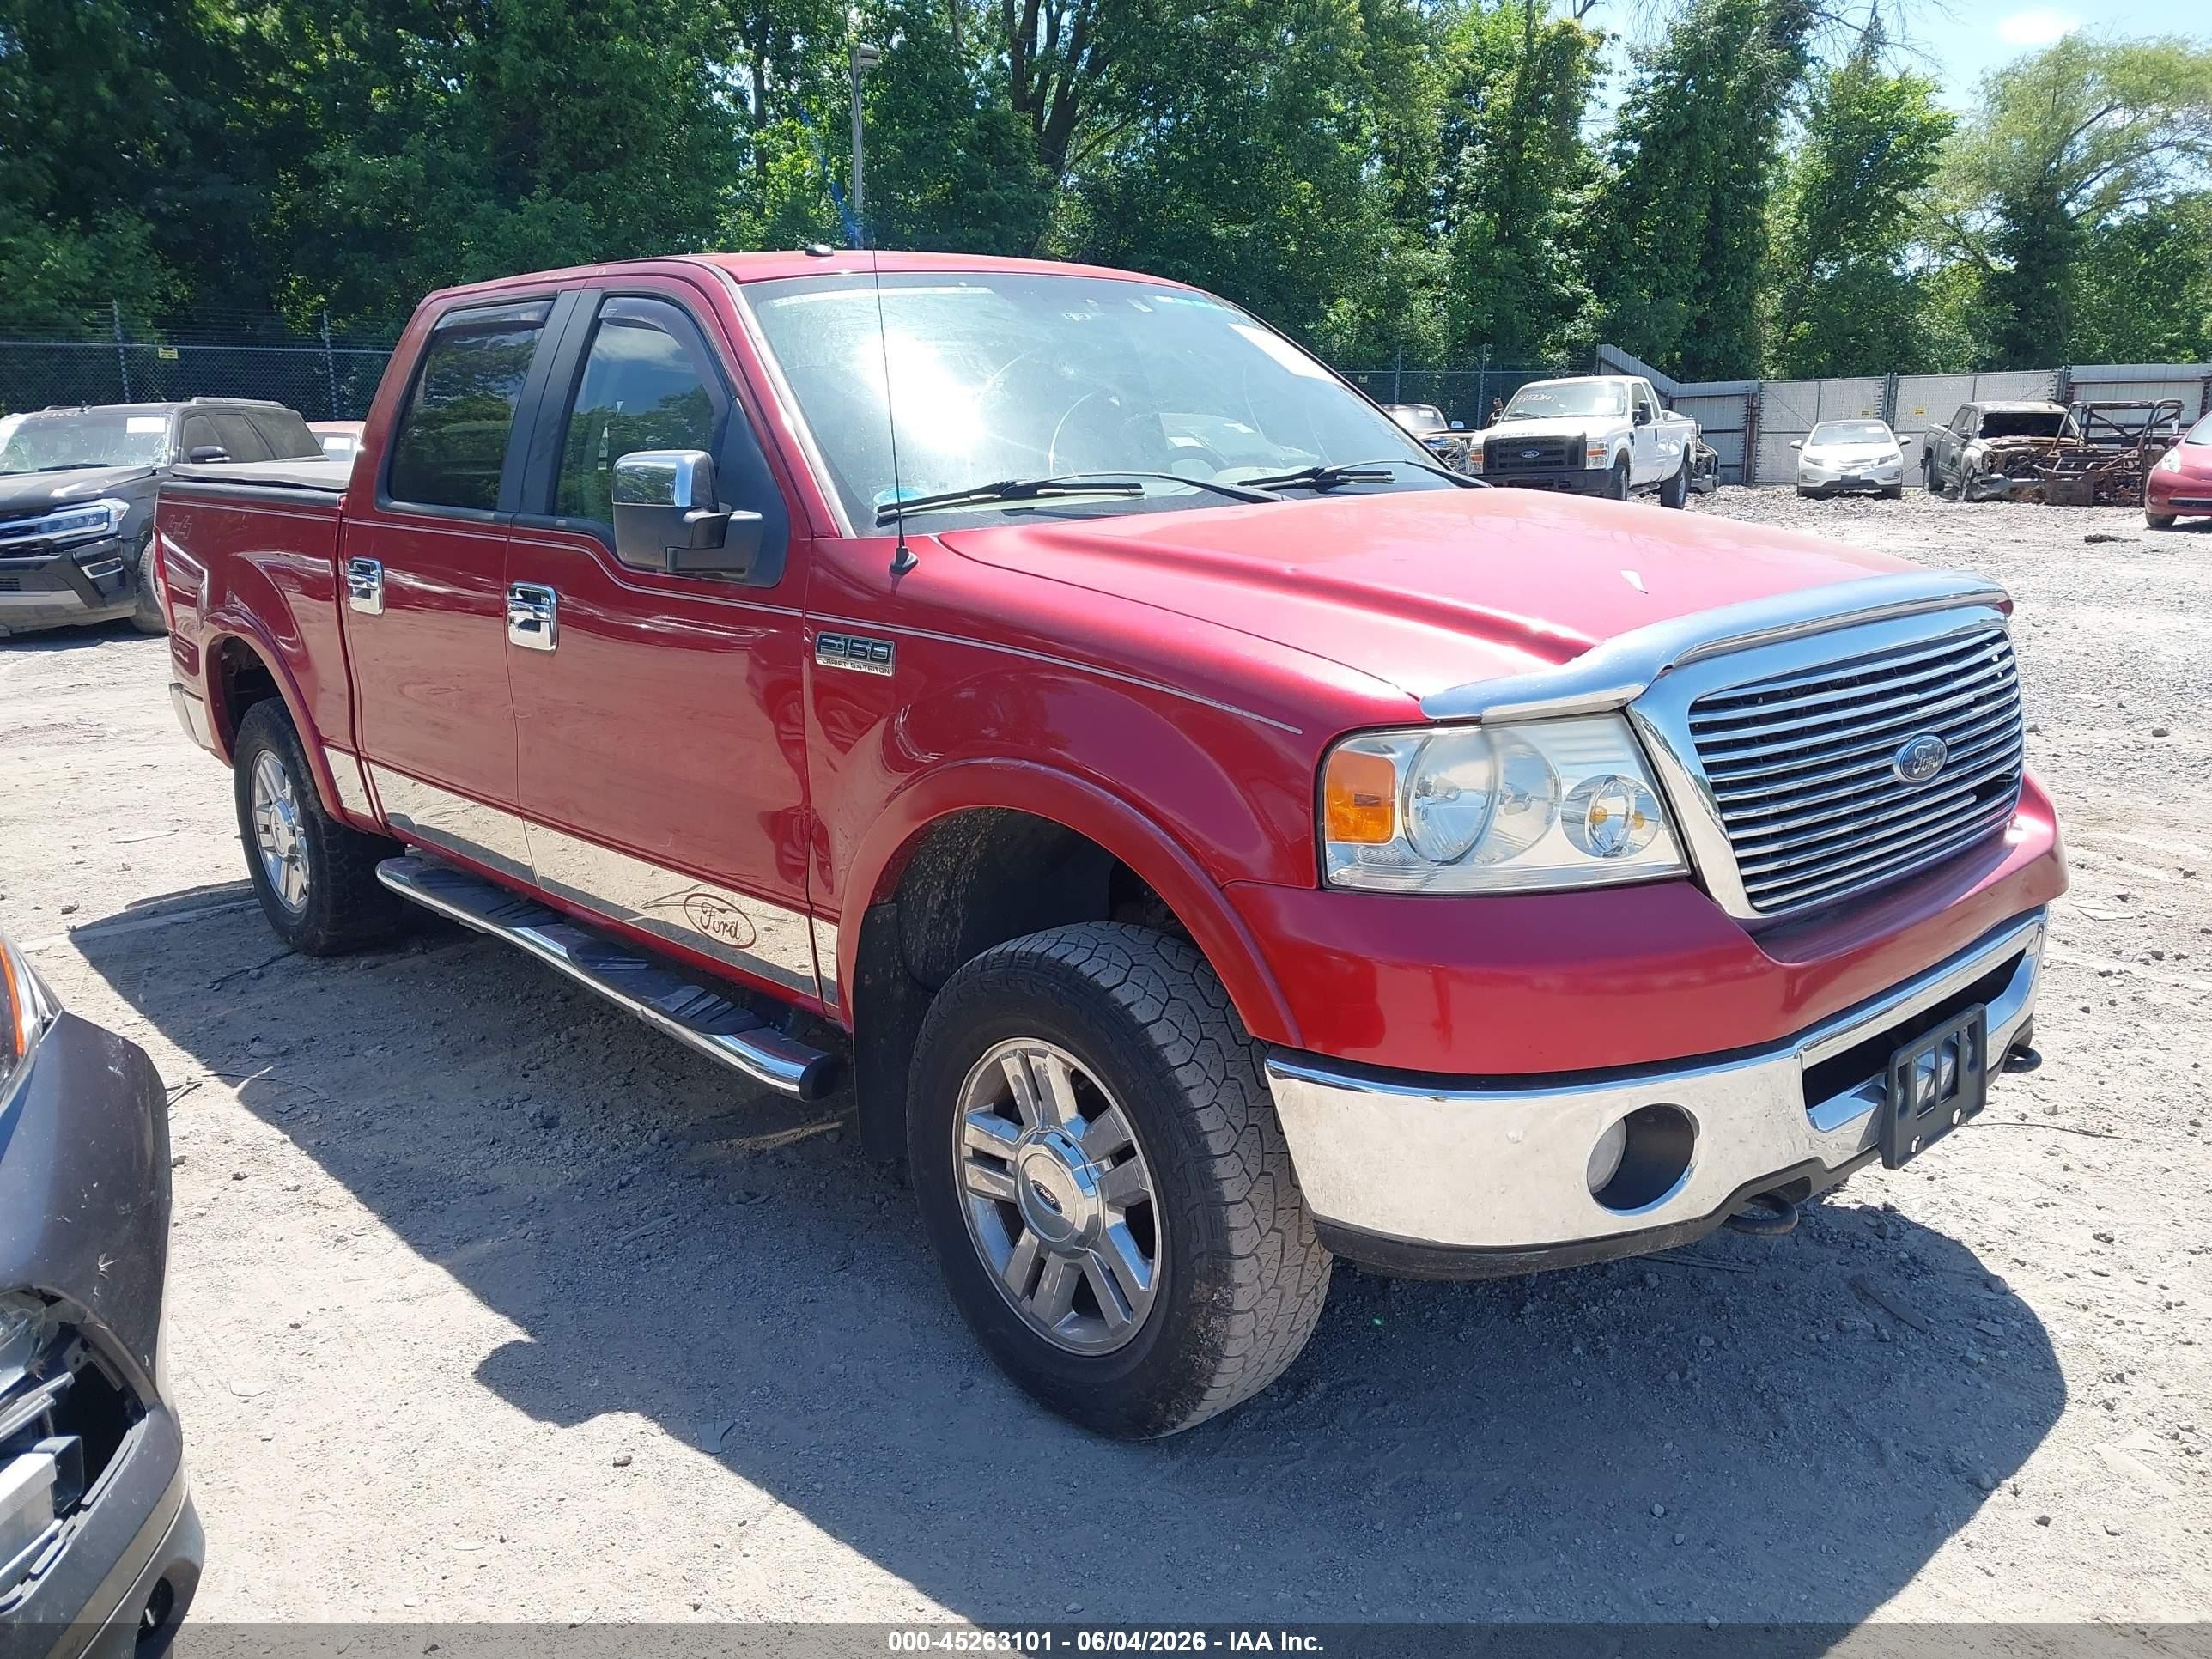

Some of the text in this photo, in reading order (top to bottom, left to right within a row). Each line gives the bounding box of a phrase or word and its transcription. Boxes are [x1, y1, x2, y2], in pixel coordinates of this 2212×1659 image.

[822, 658, 847, 667] LARIAT
[862, 665, 891, 675] TRITON
[1912, 743, 1941, 775] Ford
[699, 902, 741, 941] Ford
